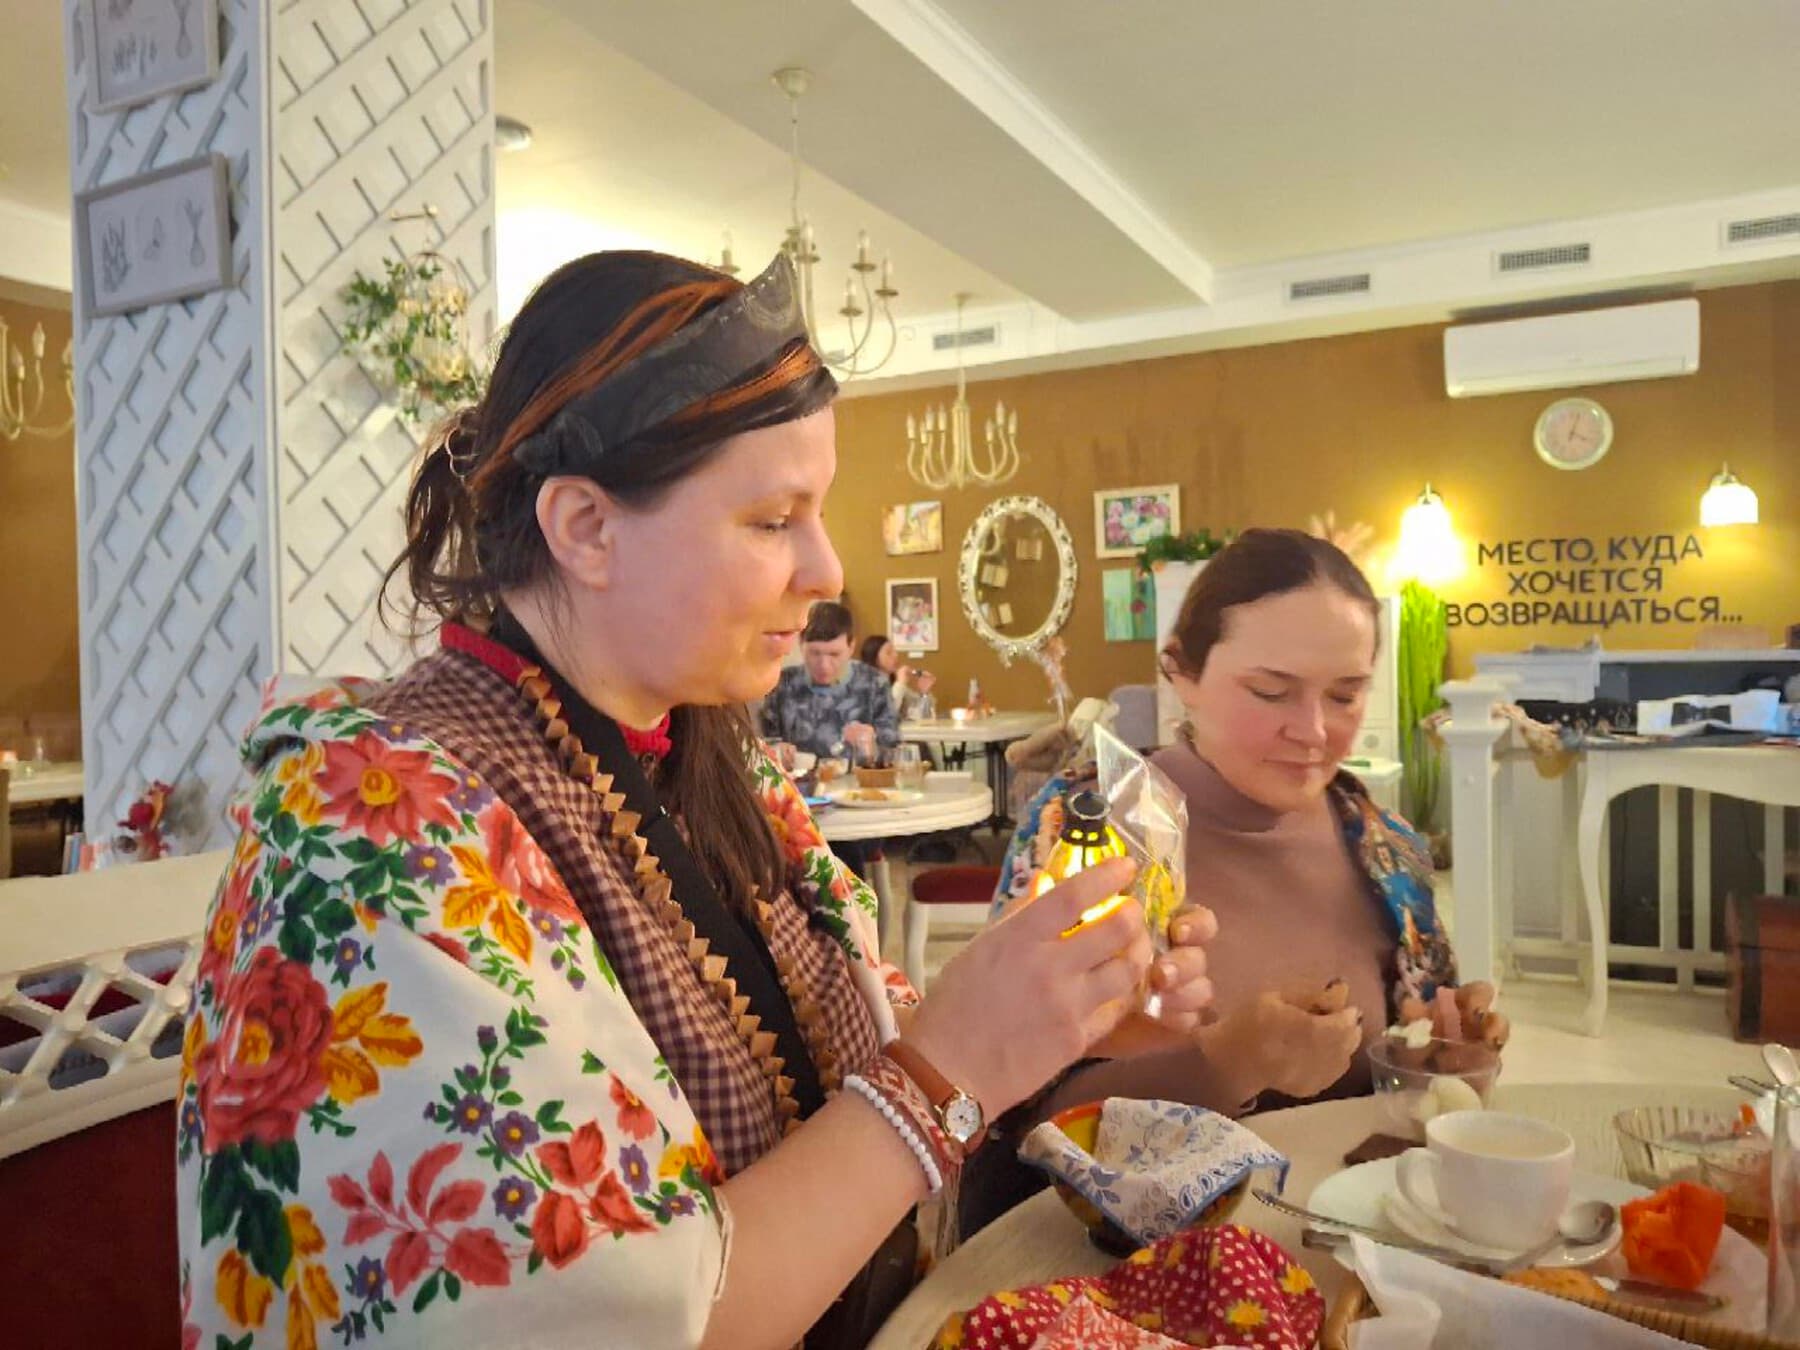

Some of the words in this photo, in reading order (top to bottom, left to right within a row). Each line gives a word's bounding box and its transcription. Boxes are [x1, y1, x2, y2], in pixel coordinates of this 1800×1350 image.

[1478, 538, 1598, 565] МЕСТО,
[1608, 534, 1703, 565] КУДА
[1508, 567, 1662, 595] ХОЧЕТСЯ
[1446, 596, 1742, 629] ВОЗВРАЩАТЬСЯ...
